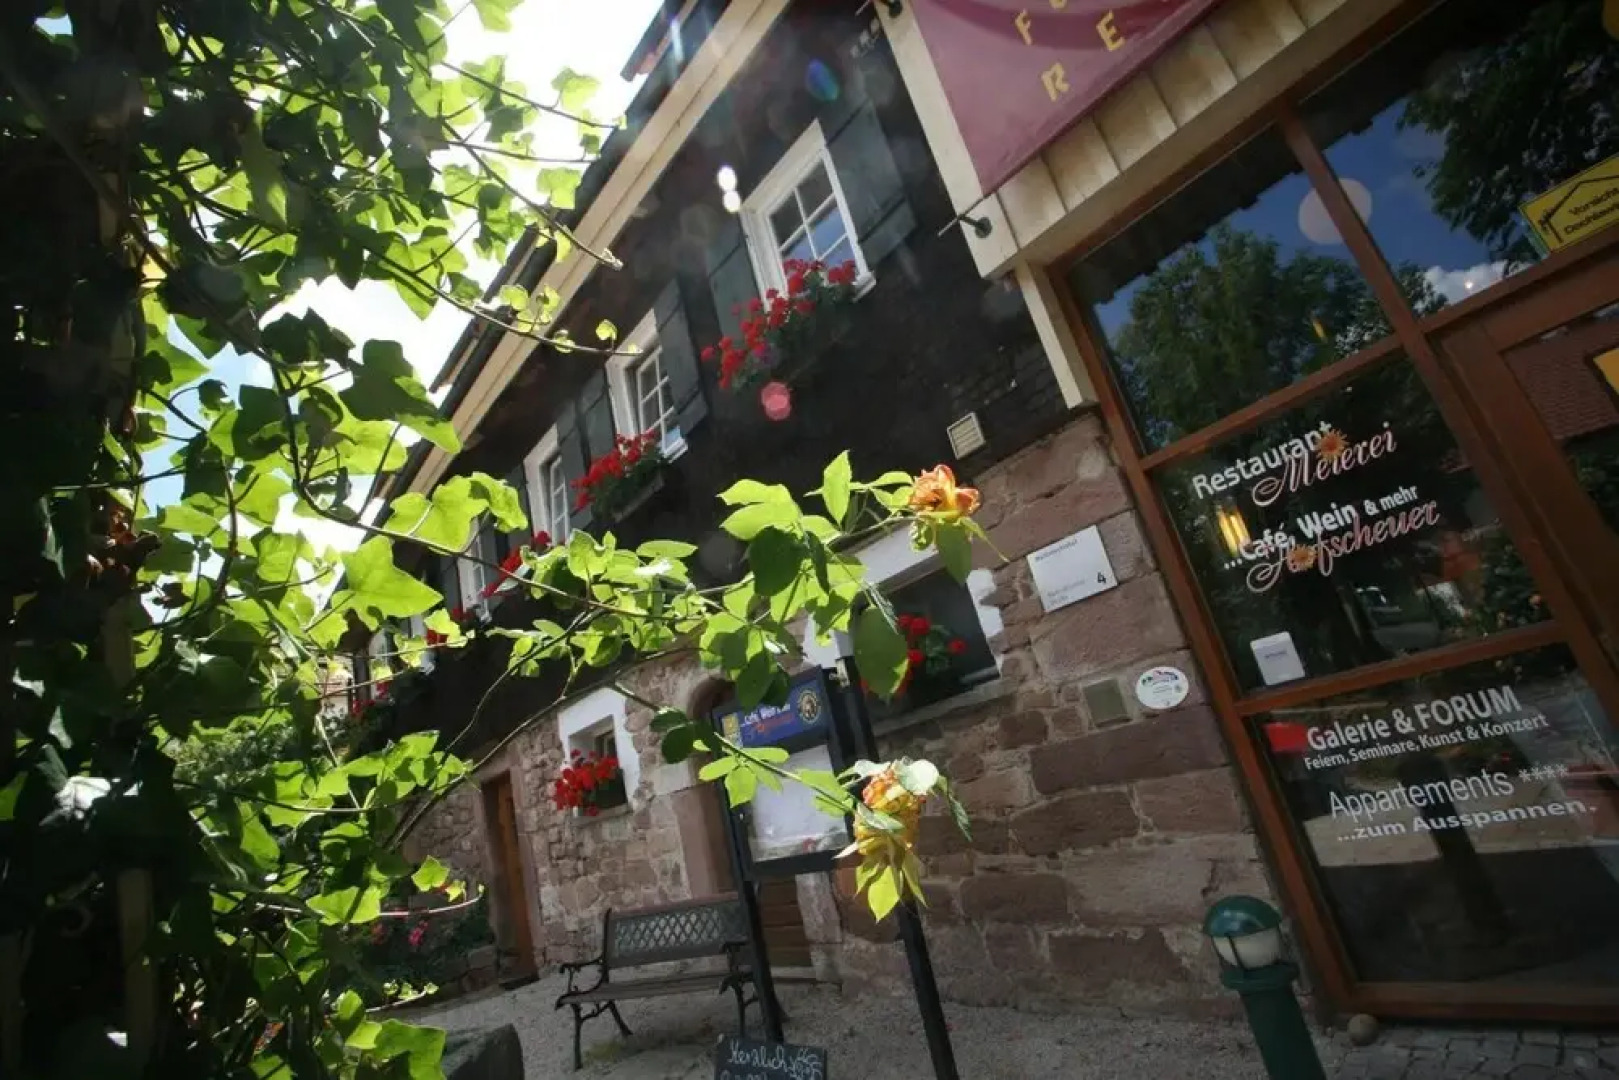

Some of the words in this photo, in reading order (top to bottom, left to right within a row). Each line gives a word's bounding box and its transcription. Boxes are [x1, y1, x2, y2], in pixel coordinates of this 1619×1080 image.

[1192, 420, 1333, 499] Restaurant
[1252, 421, 1398, 507] Meierei
[1296, 502, 1356, 540] Wein
[1363, 499, 1380, 517] &
[1379, 485, 1419, 511] mehr
[1096, 572, 1108, 585] 4
[1304, 750, 1351, 771] Feiern,
[1349, 737, 1421, 764] Seminare,
[1419, 729, 1463, 749] Kunst
[1466, 724, 1480, 741] &
[1480, 713, 1550, 739] Konzert
[1306, 715, 1392, 751] Galerie
[1393, 708, 1416, 734] &
[1414, 685, 1523, 730] FORUM
[1328, 768, 1515, 823] Appartements
[1412, 800, 1598, 833] Ausspannen.
